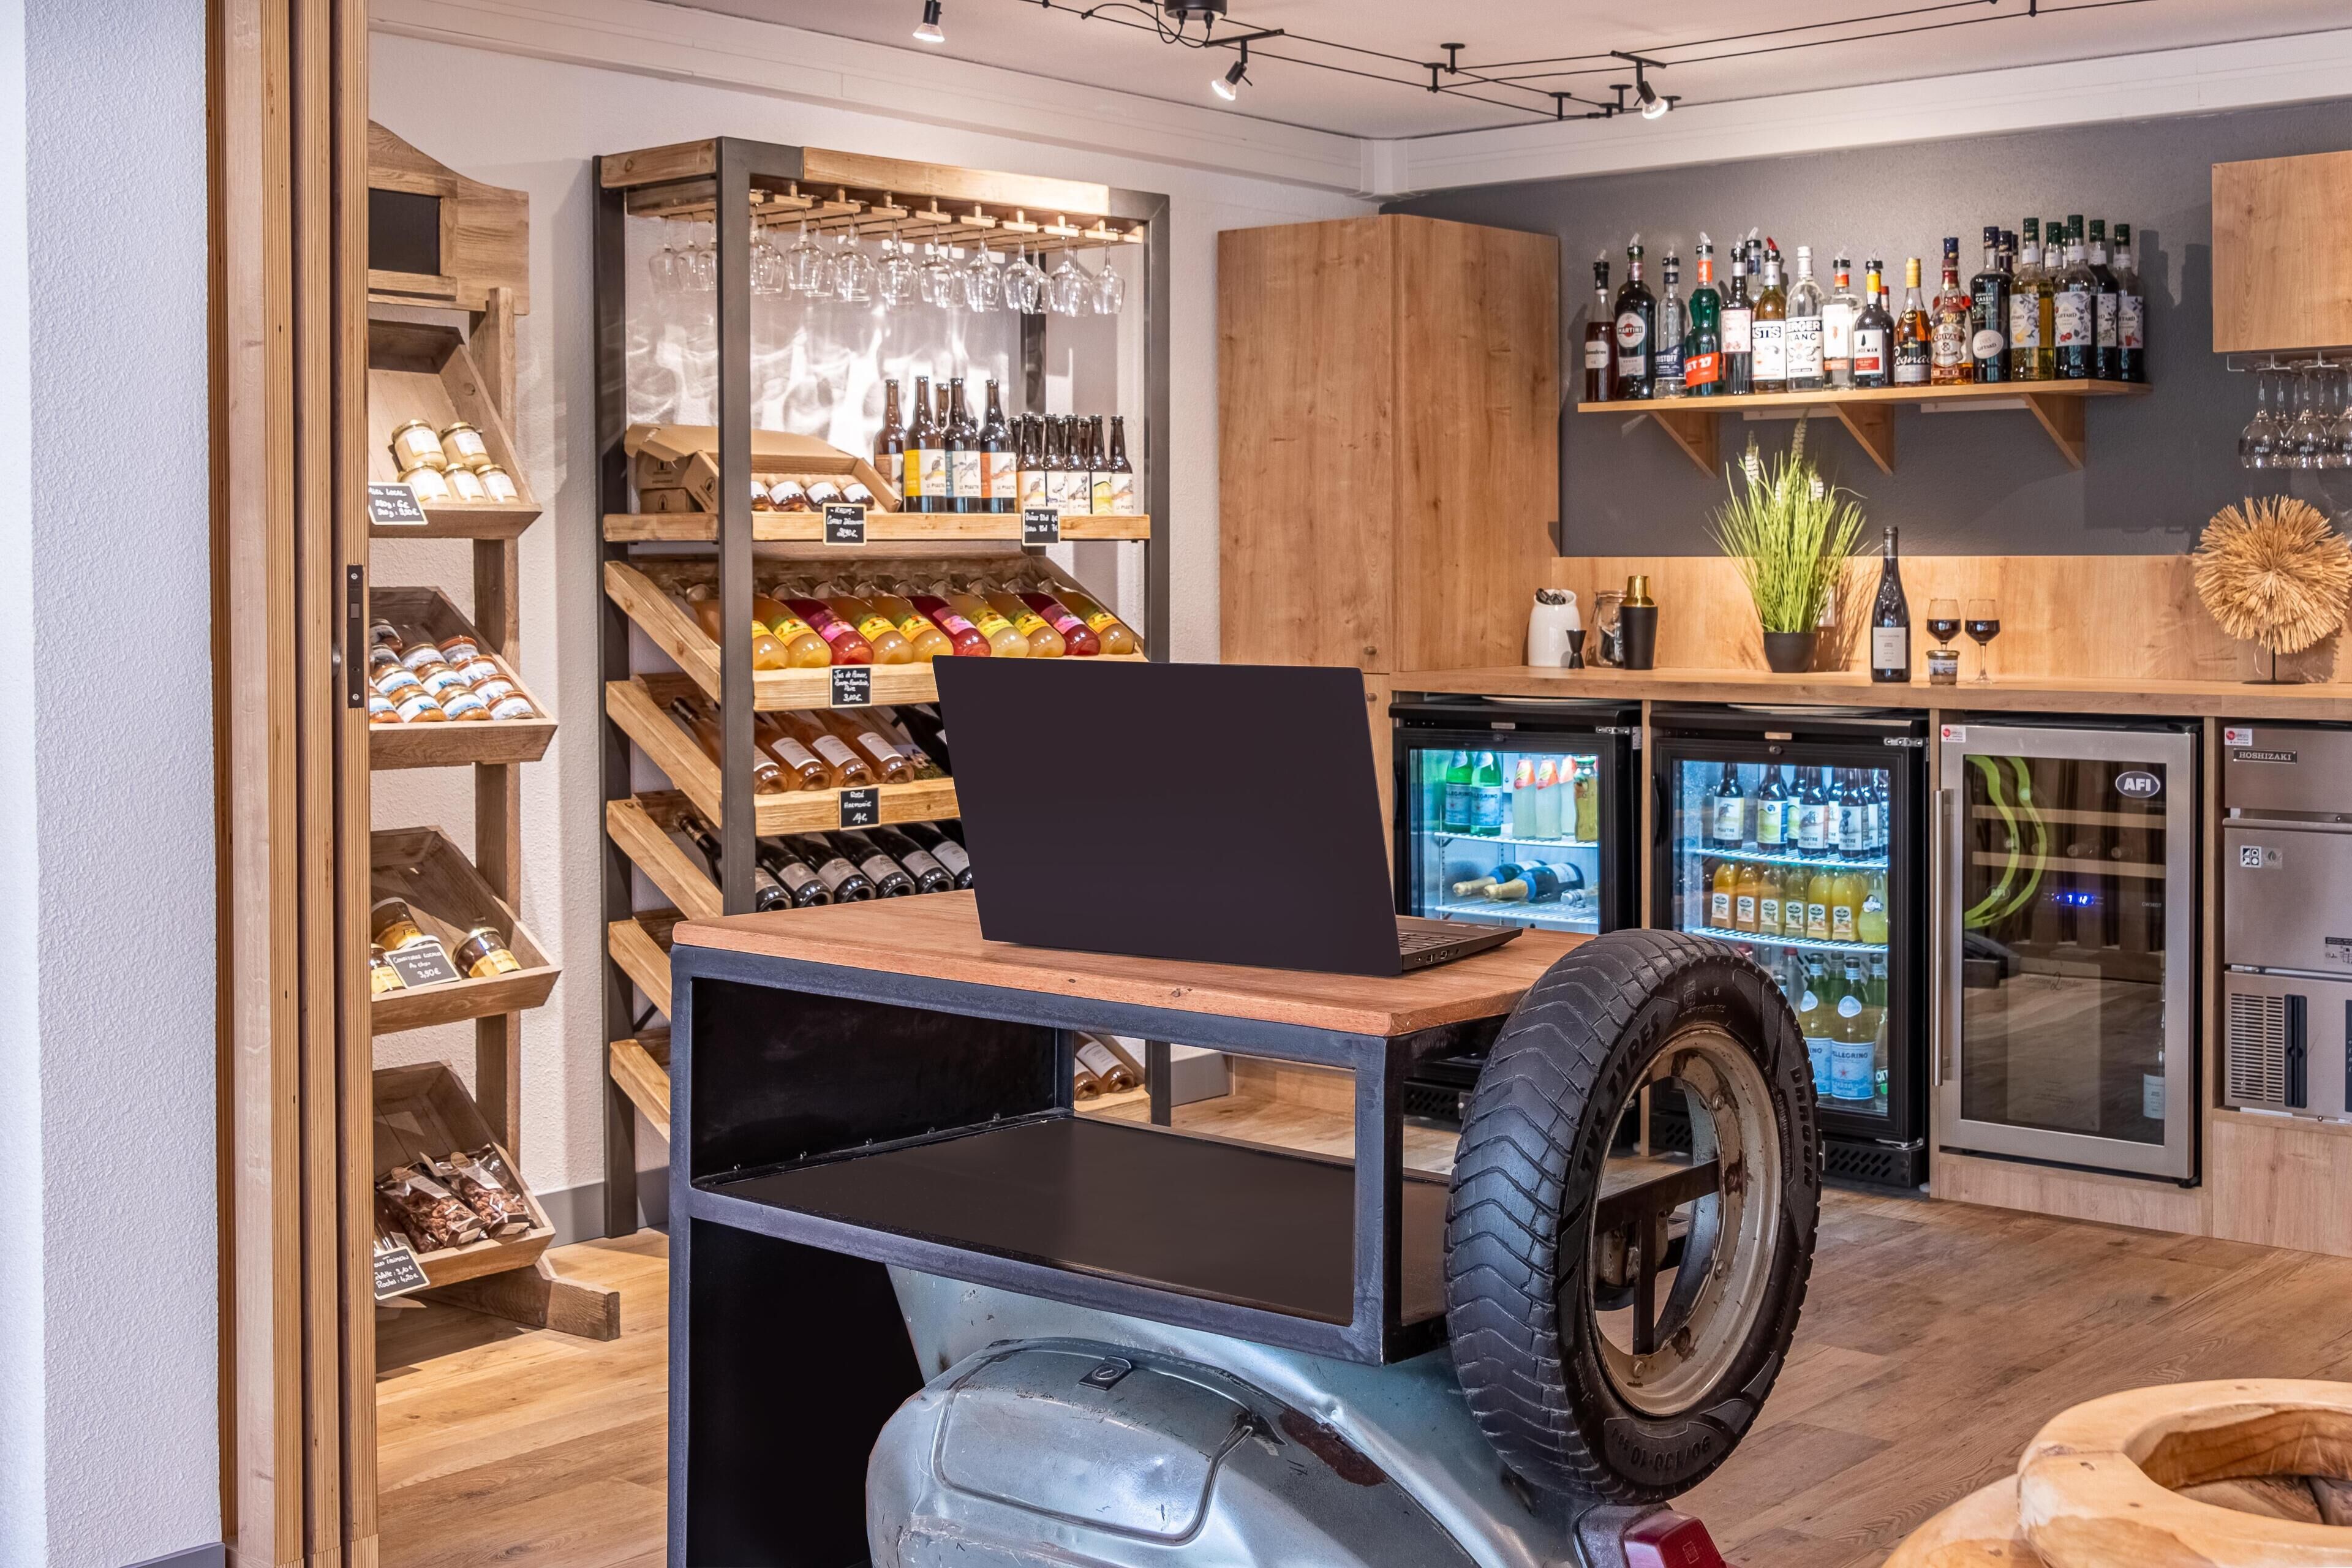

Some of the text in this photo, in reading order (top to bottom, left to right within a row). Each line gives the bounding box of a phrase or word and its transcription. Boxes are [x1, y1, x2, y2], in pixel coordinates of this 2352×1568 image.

[1617, 326, 1643, 334] MARTINI
[2239, 752, 2292, 761] HOSHIZAKI
[2123, 777, 2151, 792] AFI
[1606, 1009, 1660, 1101] TYRES
